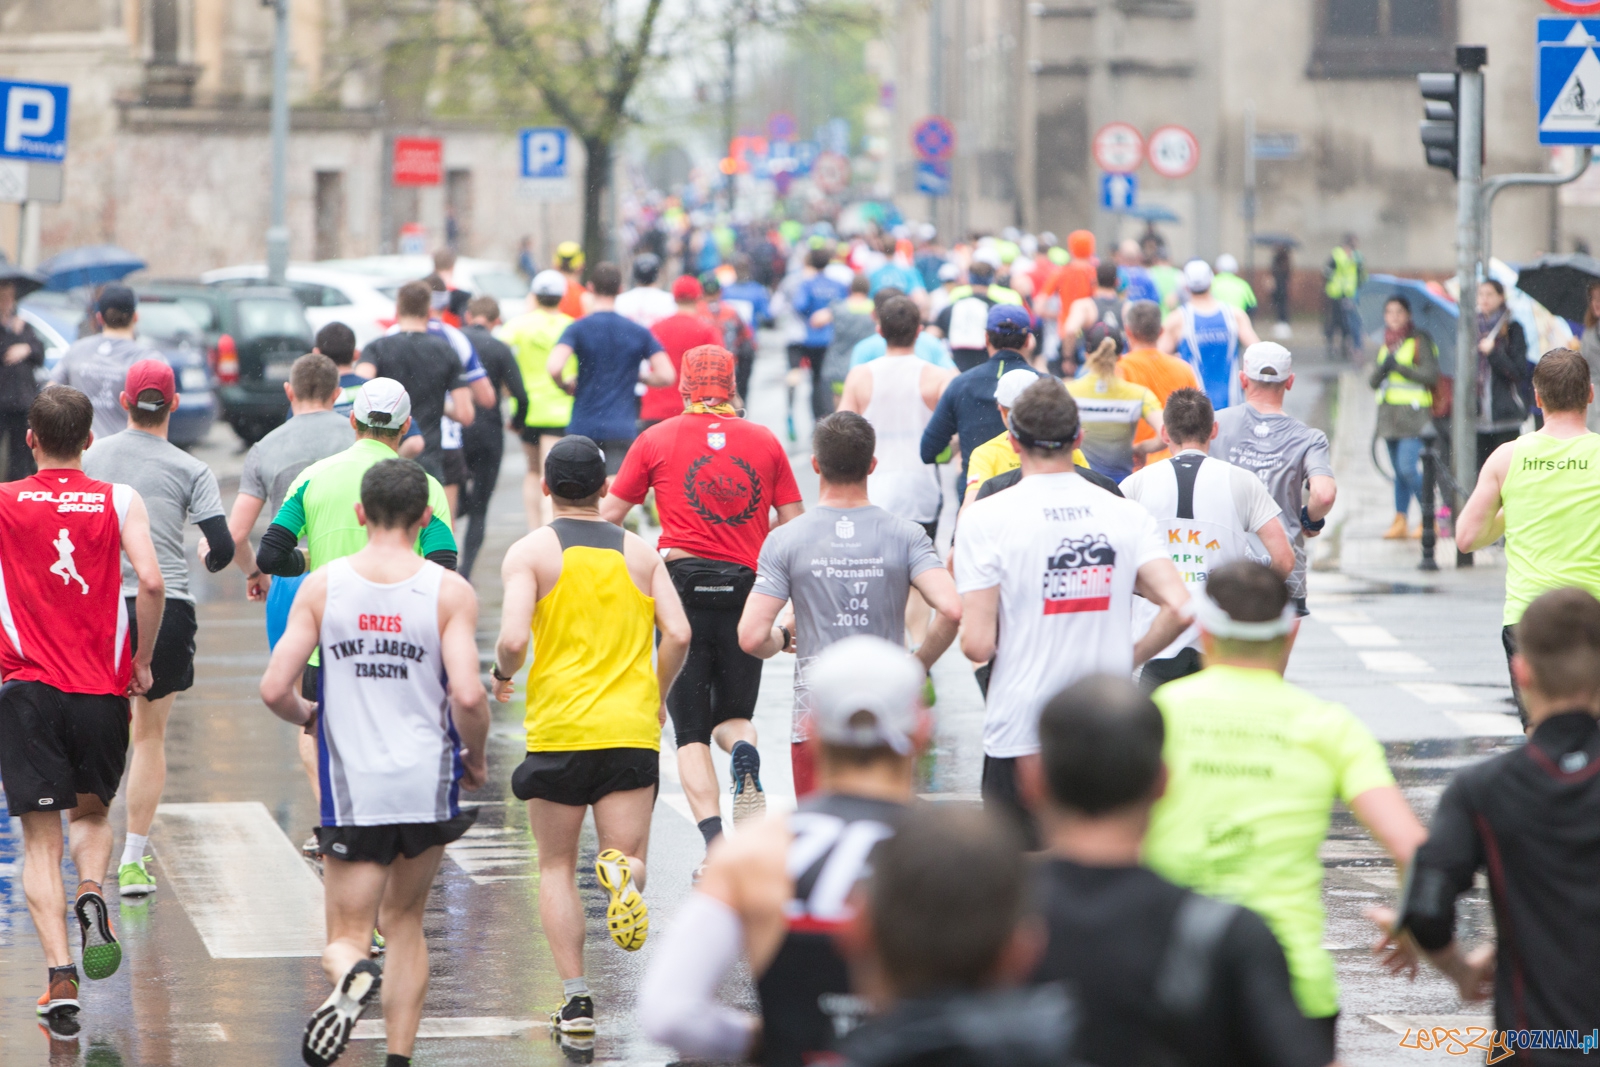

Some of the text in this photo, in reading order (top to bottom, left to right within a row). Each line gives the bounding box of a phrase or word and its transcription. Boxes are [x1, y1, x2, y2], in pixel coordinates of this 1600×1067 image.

[1523, 457, 1588, 471] hirschu
[17, 491, 106, 503] POLONIA
[57, 501, 105, 513] ŚRODA
[1043, 506, 1094, 521] PATRYK
[811, 557, 828, 567] Mój
[848, 556, 884, 566] pozostał
[811, 565, 884, 579] w Poznaniu
[853, 581, 868, 595] 17
[844, 597, 870, 611] .04
[358, 612, 403, 634] GRZEŚ
[832, 613, 870, 627] .2016
[329, 638, 365, 660] TKKF
[354, 661, 409, 681] ZBĄSZYŃ
